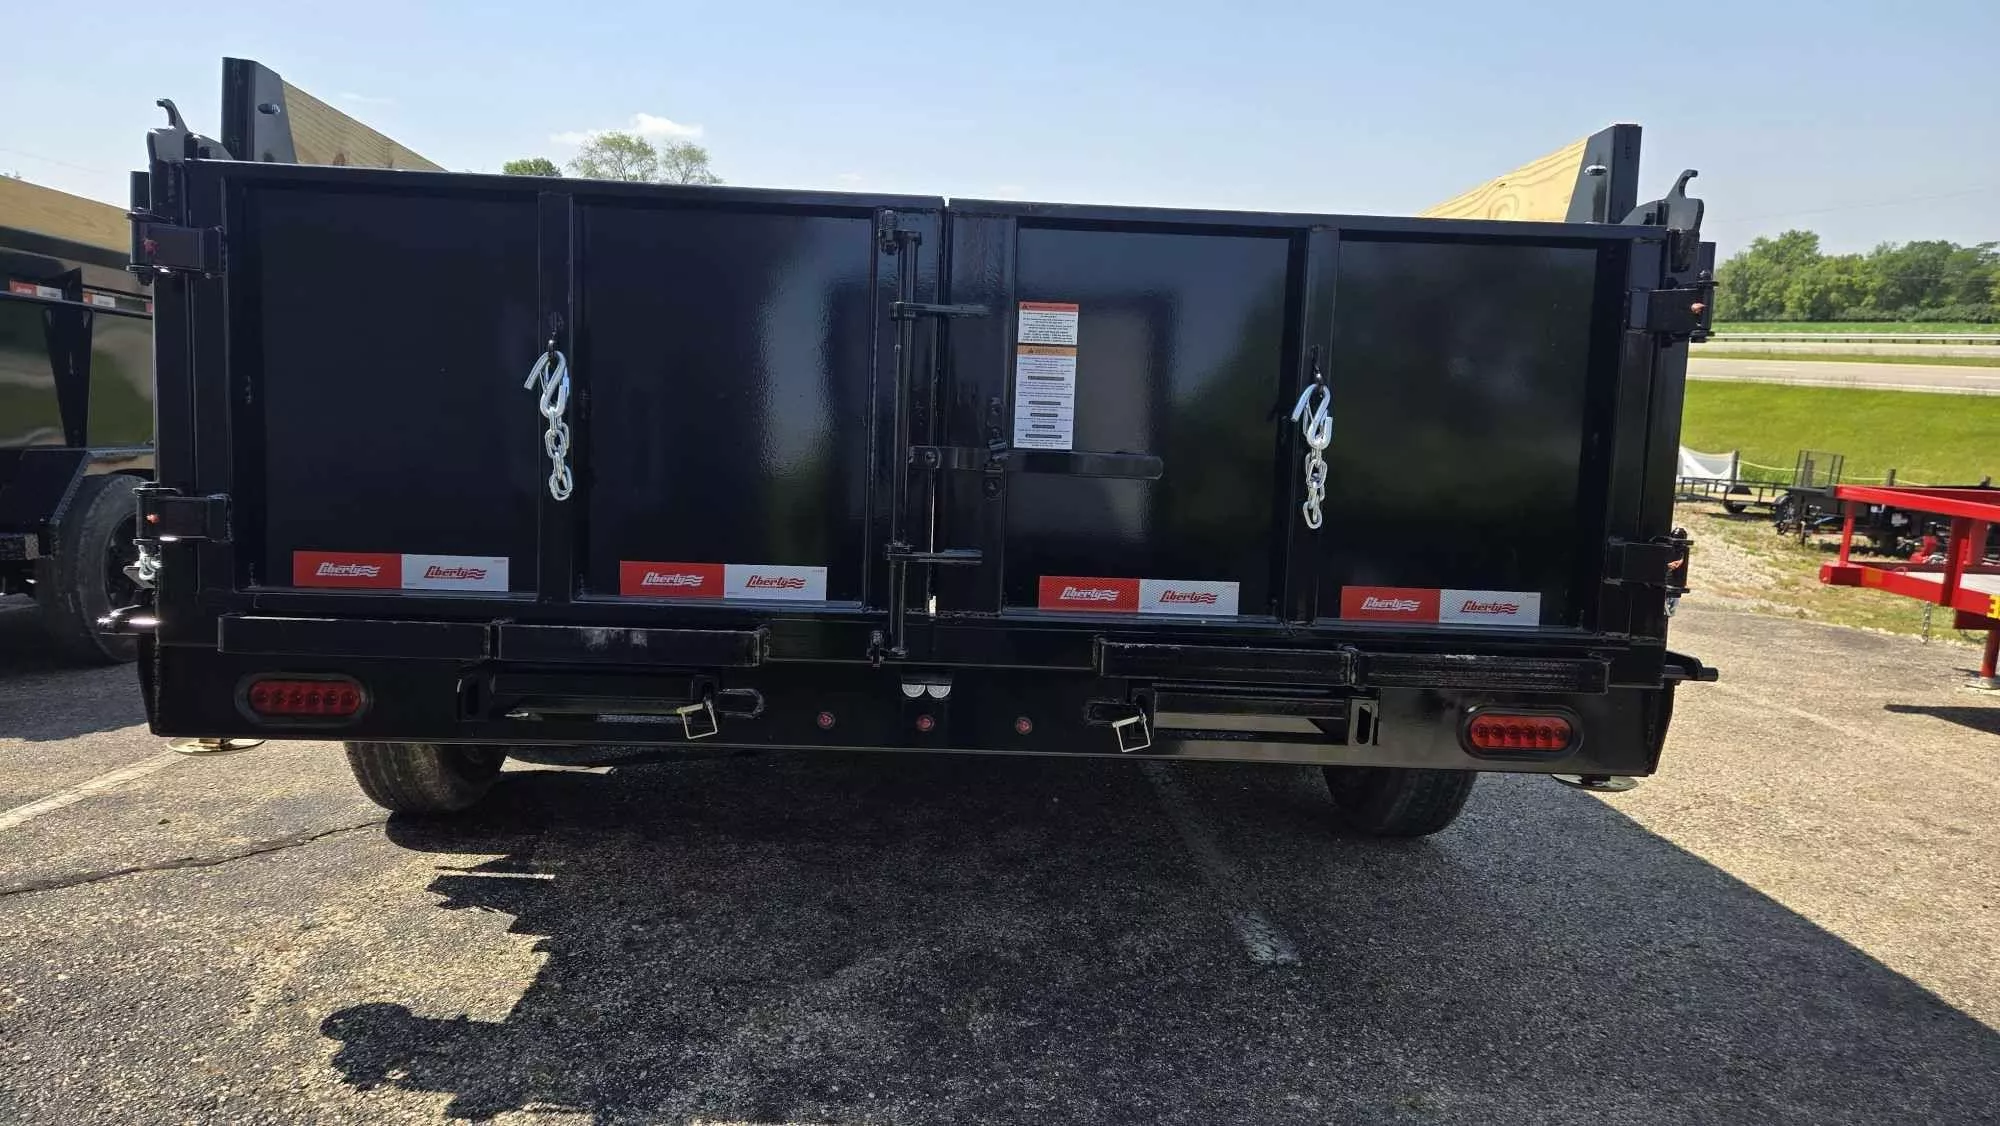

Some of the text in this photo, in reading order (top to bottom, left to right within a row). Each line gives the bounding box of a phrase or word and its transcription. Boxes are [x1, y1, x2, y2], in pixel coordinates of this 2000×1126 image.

[316, 562, 468, 579] Liberty Liberty
[641, 572, 788, 588] Liberty Liberty
[1059, 587, 1201, 604] Liberty Liberty
[1361, 597, 1501, 614] Liberty Liberty
